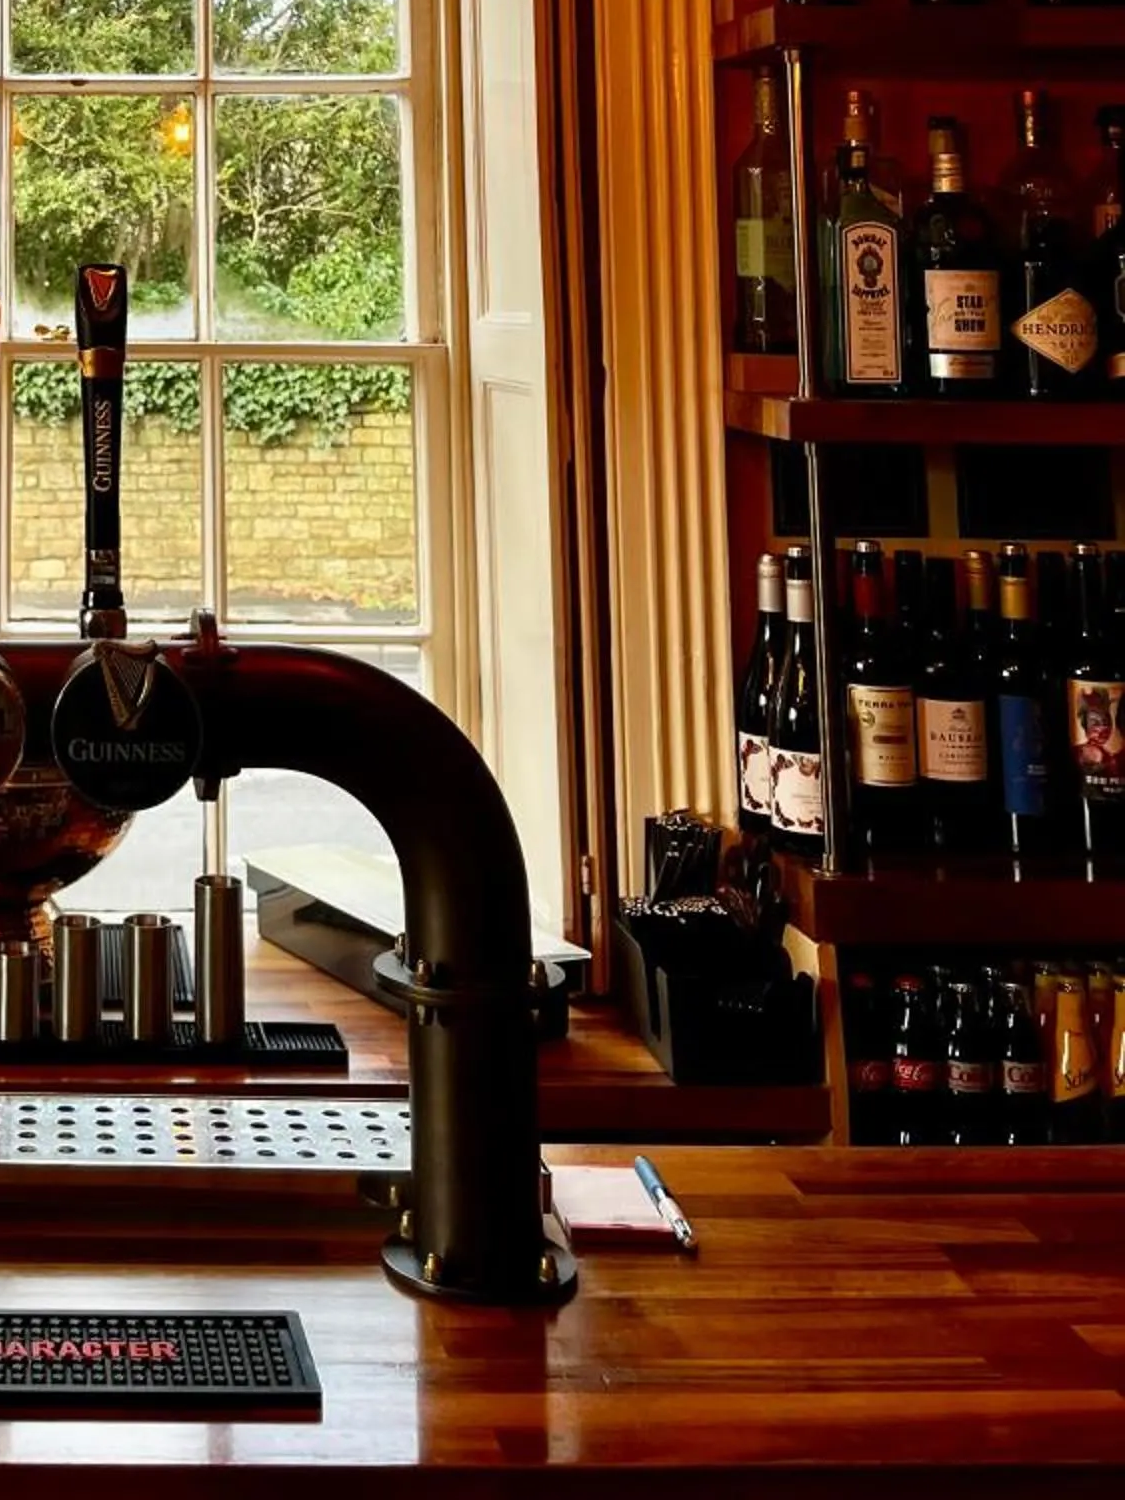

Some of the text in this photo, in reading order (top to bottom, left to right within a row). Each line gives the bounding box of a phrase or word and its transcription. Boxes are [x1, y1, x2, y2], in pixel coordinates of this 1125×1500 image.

[1022, 323, 1084, 335] HENDRI
[92, 400, 112, 492] GUINNESS
[67, 737, 186, 764] GUINNESS
